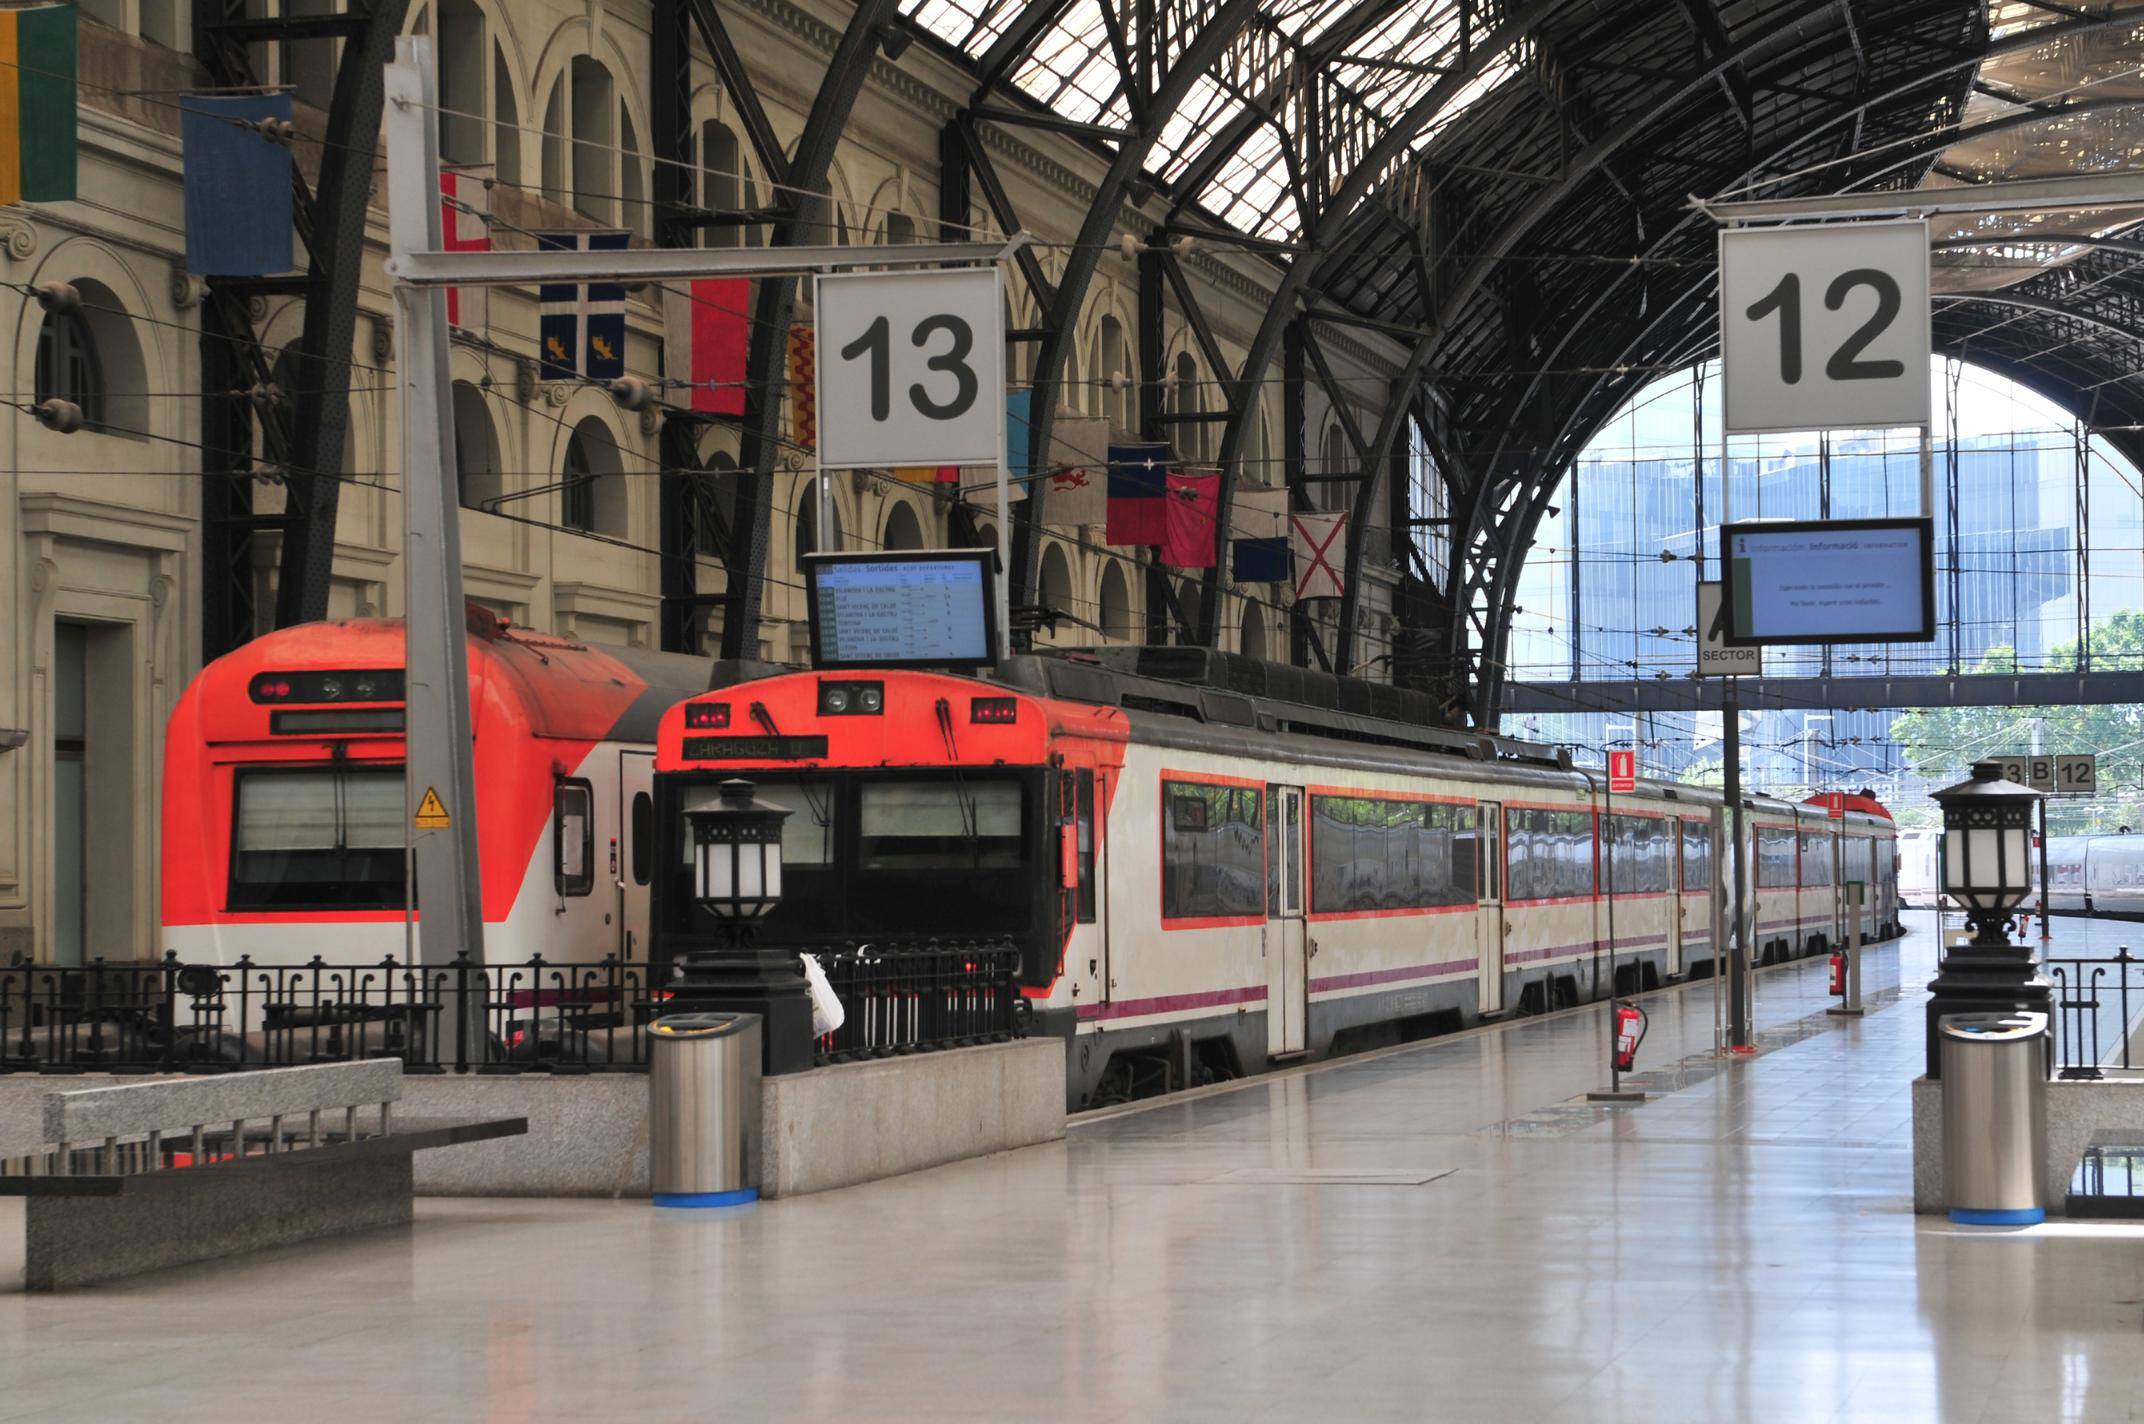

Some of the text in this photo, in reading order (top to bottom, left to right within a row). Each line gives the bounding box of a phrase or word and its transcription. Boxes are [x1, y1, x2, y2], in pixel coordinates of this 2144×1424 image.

[1746, 268, 1905, 385] 12
[841, 314, 978, 422] 13
[1703, 650, 1755, 661] SECTOR
[2033, 762, 2049, 780] B
[2061, 763, 2091, 783] 12
